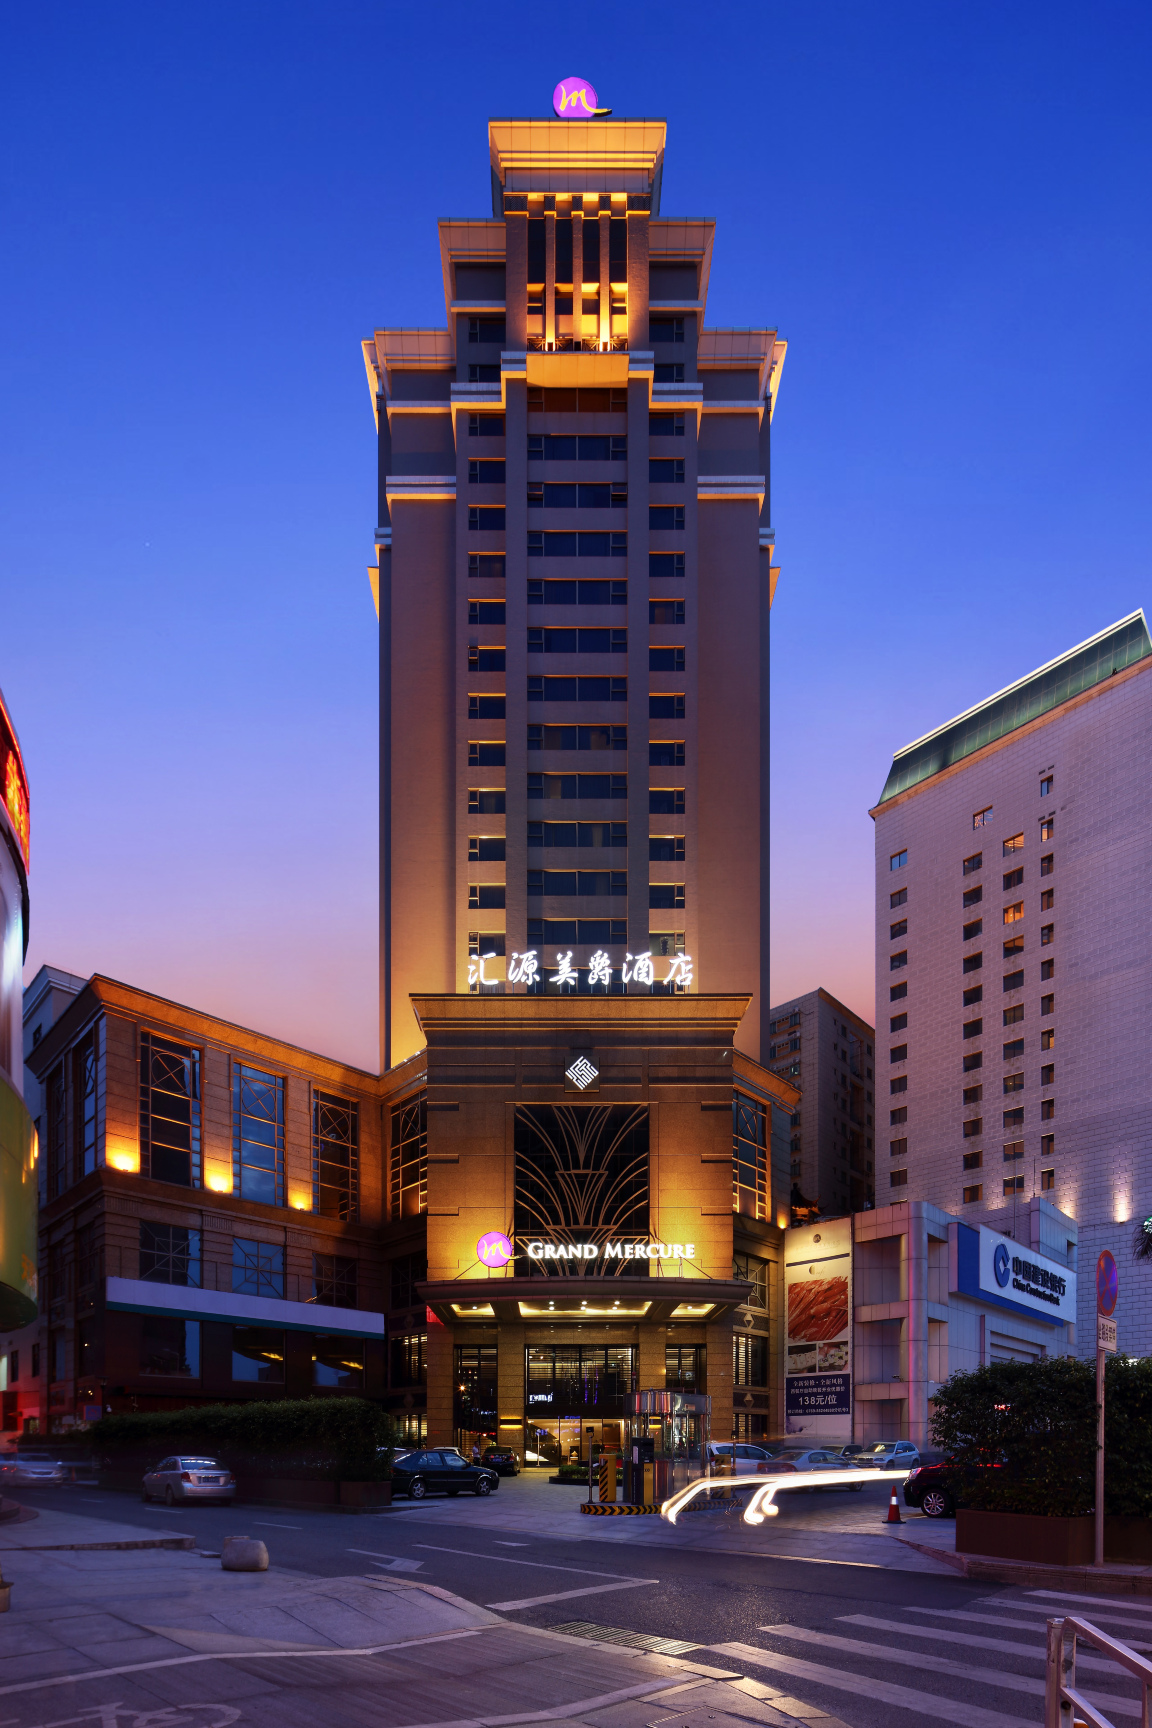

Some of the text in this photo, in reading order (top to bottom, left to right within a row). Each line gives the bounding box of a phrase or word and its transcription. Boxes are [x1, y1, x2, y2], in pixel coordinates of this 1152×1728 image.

[467, 950, 694, 986] 汇源美爵酒店
[527, 1242, 695, 1259] GRAND MERCURE
[1012, 1256, 1066, 1297] 中国建设银行
[798, 1394, 838, 1405] 138元/位
